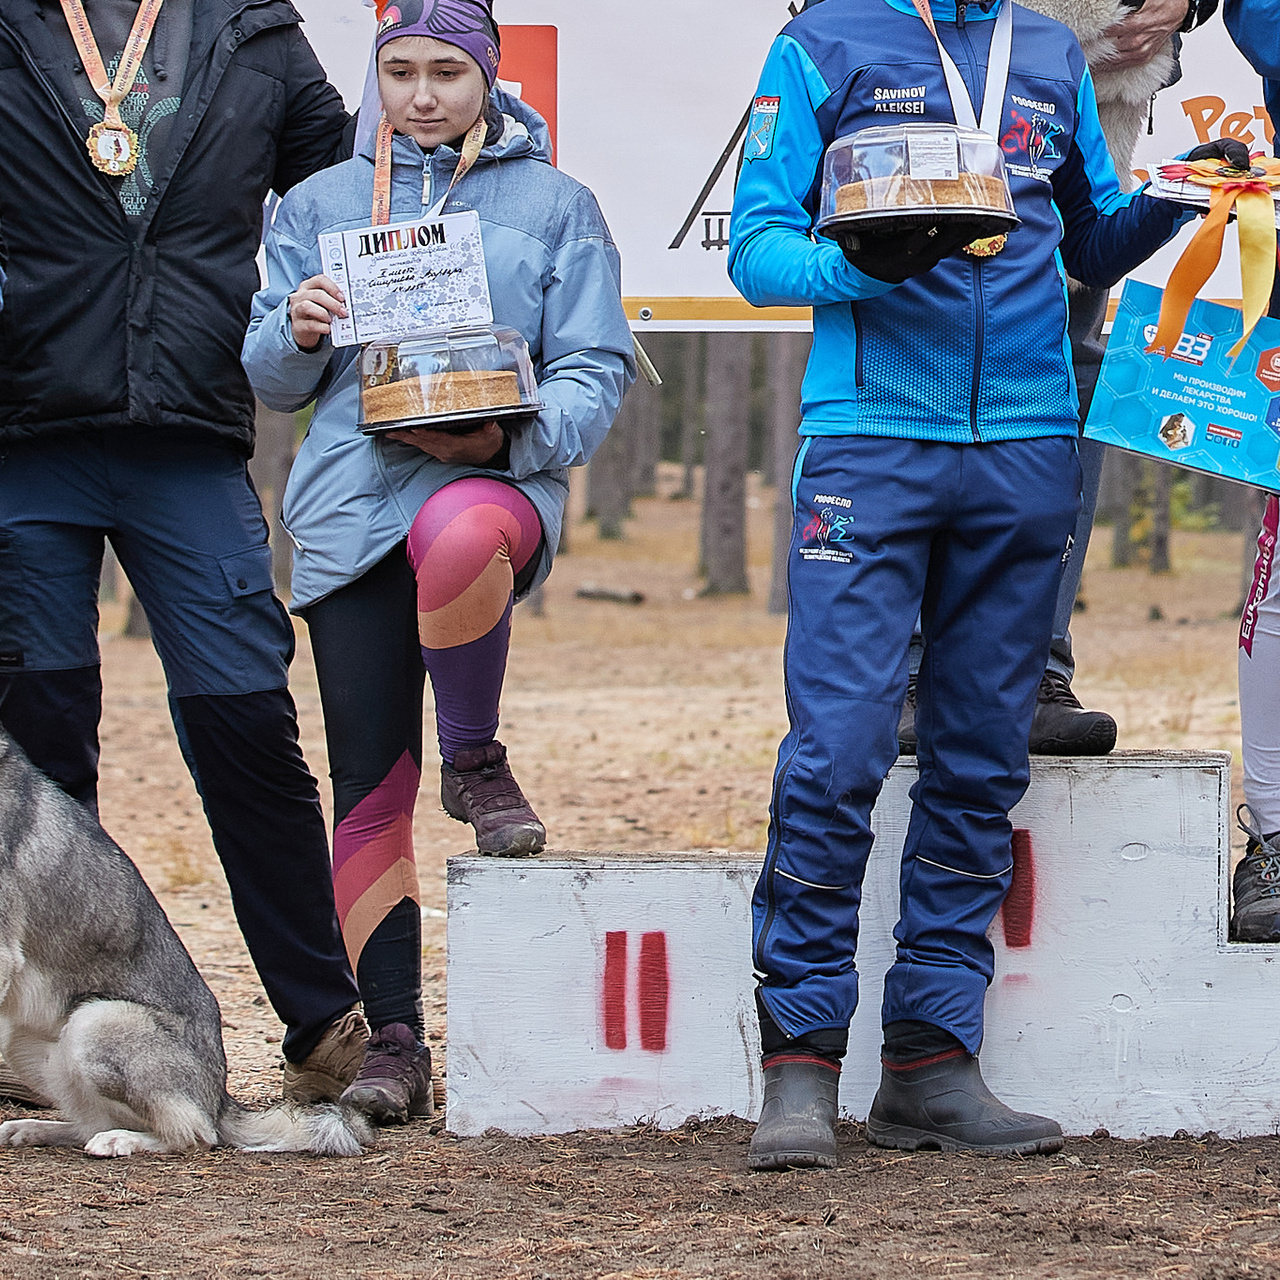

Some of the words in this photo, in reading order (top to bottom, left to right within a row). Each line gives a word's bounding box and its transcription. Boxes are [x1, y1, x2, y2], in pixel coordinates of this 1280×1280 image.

[874, 86, 926, 100] SAVINOV
[874, 101, 925, 114] ALEKSEI
[358, 223, 446, 257] ДИПЛОМ
[1172, 333, 1212, 361] ВЗ
[1173, 372, 1188, 380] МЫ
[1188, 377, 1247, 399] ПРОИЗВОДИМ
[1182, 386, 1231, 405] ЛЕКАРСТВА
[1152, 387, 1159, 395] И
[1159, 389, 1196, 405] ДЕЛАЕМ
[1197, 400, 1215, 410] ЭТО
[1216, 405, 1258, 422] ХОРОШО!
[1241, 535, 1275, 640] Eukanuba
